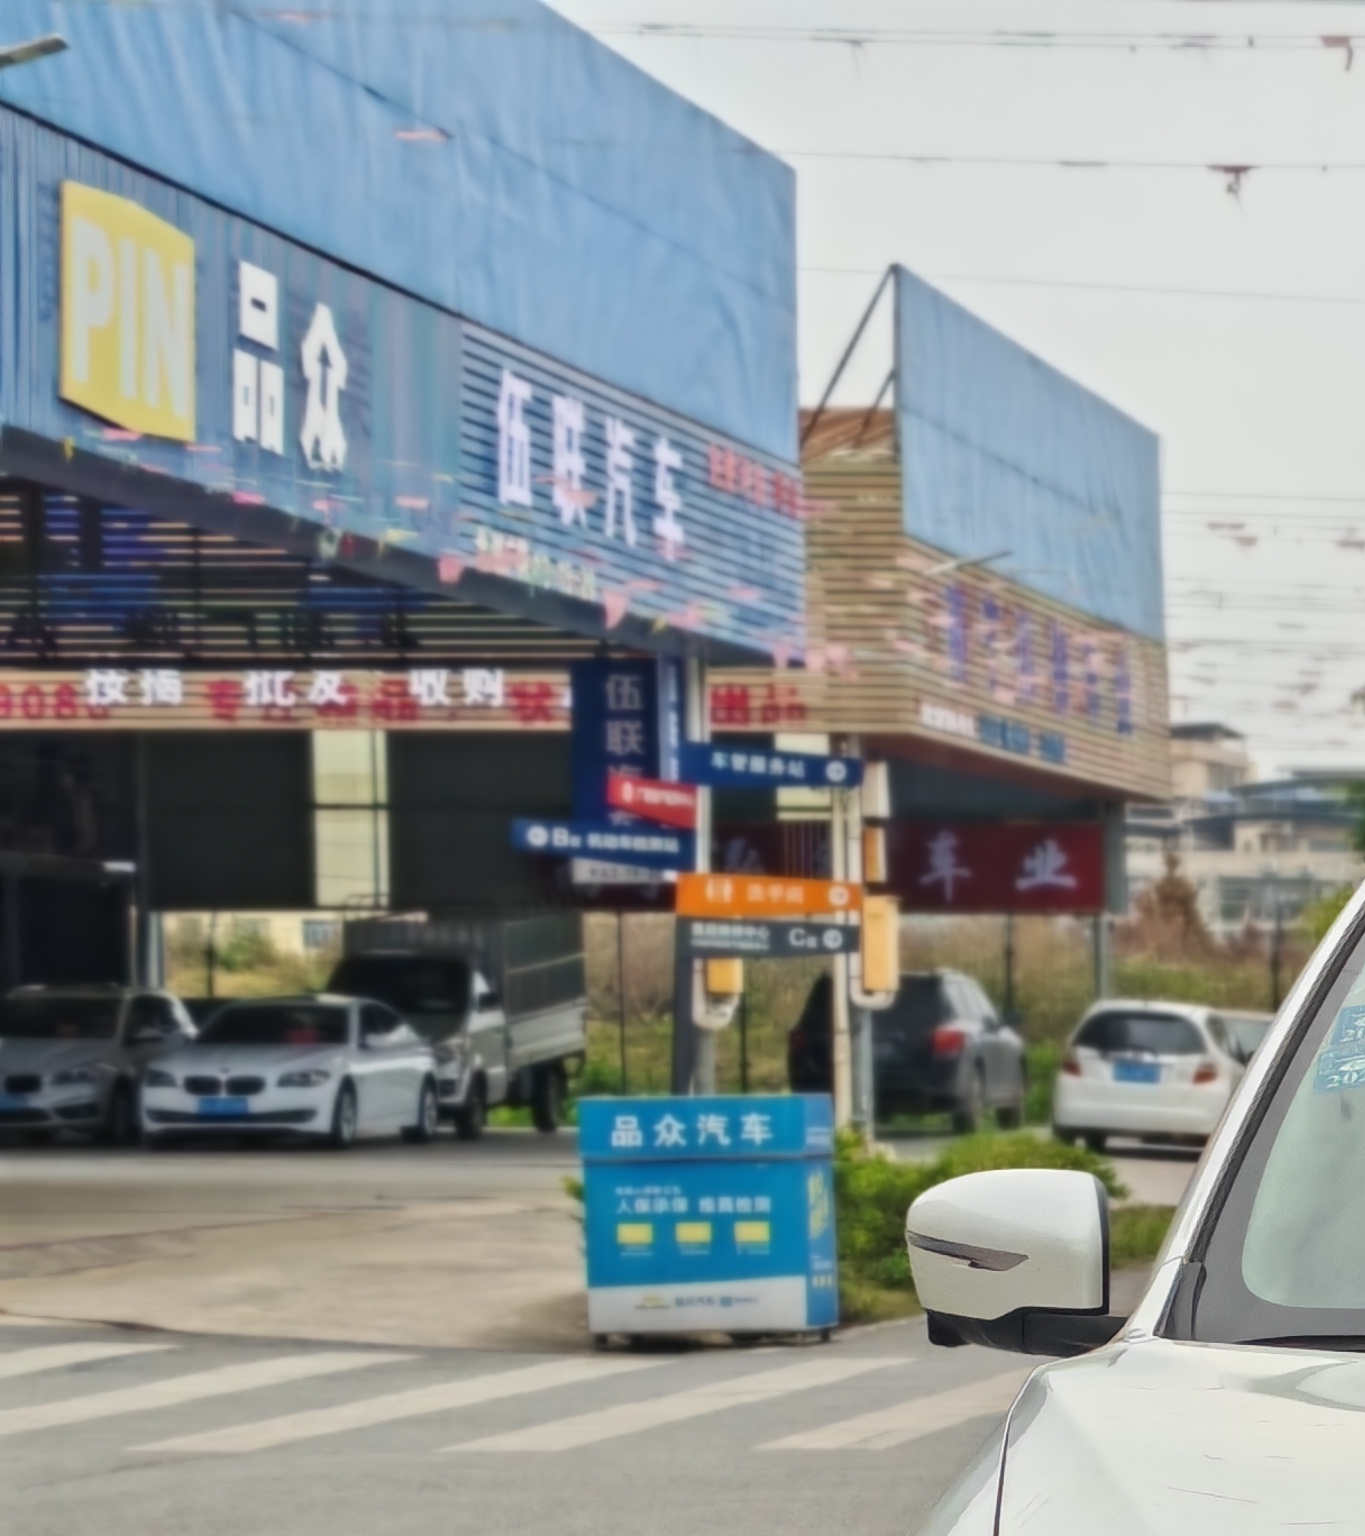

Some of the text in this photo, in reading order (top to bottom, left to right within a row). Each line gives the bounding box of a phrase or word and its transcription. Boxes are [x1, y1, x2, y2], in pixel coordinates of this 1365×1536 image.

[70, 215, 191, 424] PIN
[232, 259, 348, 471] 品众
[496, 368, 686, 563] 伍联汽车
[611, 1113, 772, 1147] 品众汽车
